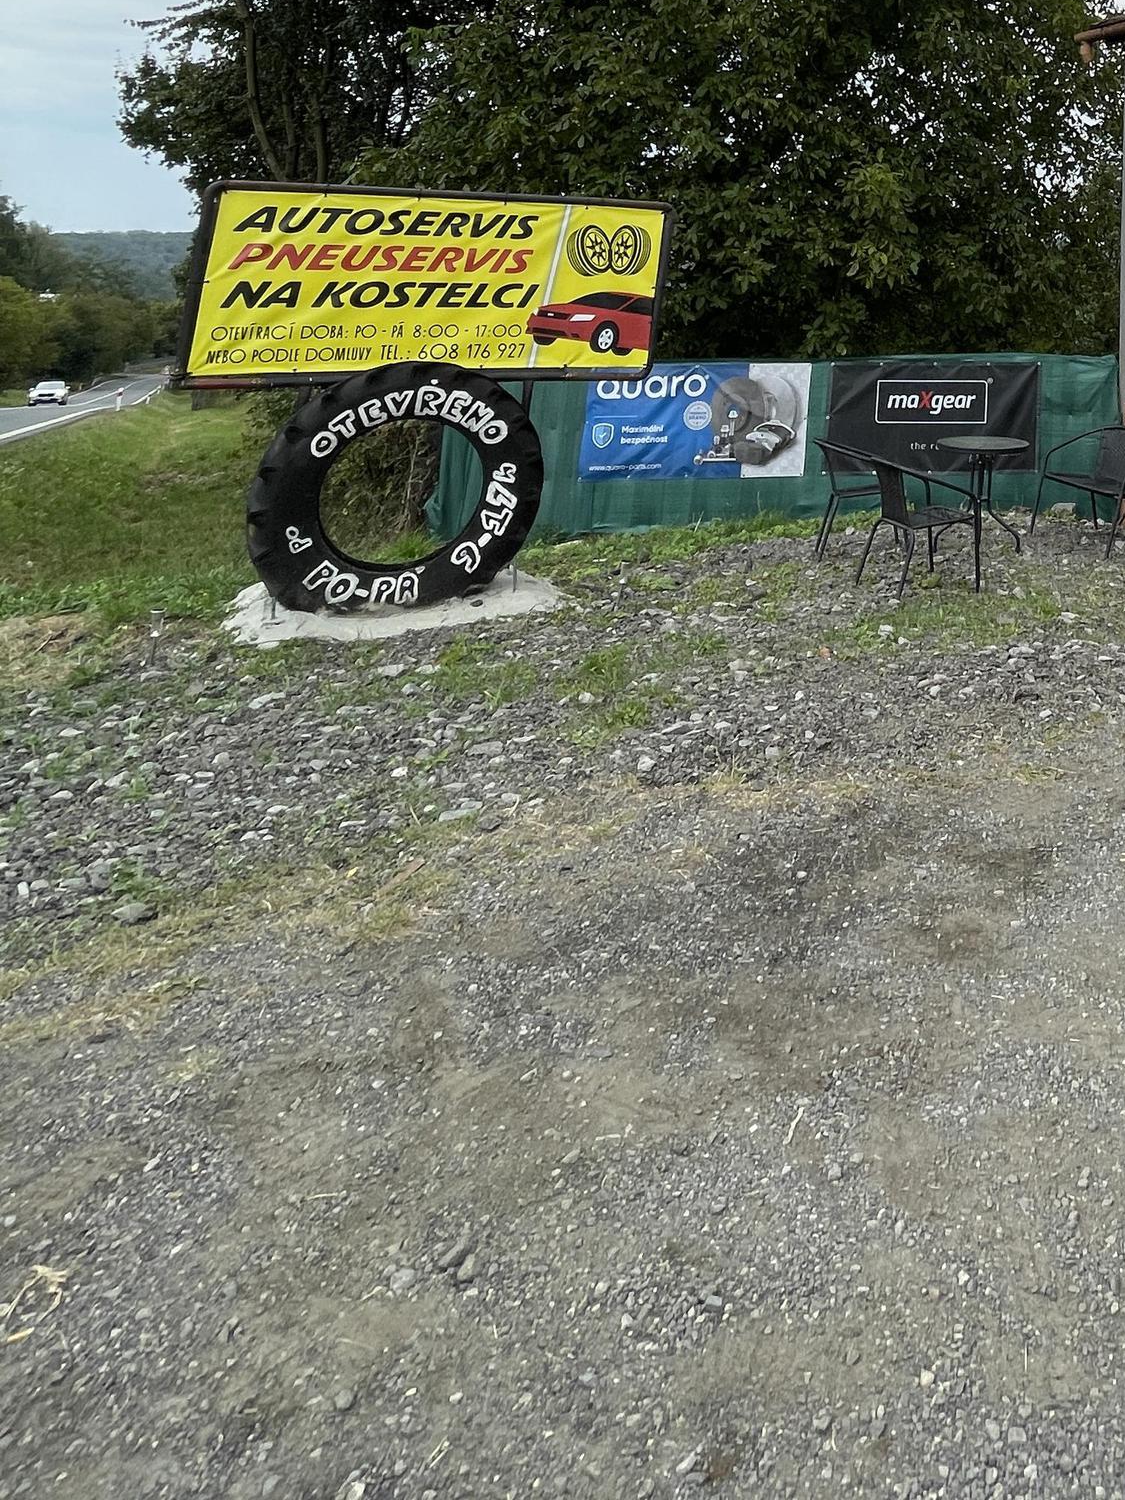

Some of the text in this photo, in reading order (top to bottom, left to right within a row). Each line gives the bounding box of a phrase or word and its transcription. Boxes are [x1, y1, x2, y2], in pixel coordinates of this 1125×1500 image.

[233, 206, 539, 239] AUTOSERVIS
[227, 243, 534, 274] PNEUSERVIS
[219, 281, 540, 309] NA KOSTELCI
[211, 322, 296, 341] OTEVÍRACÍ
[300, 325, 349, 340] DOBA:
[354, 324, 377, 339] PO
[391, 321, 405, 338] PÁ
[412, 323, 459, 338] 8:00
[475, 323, 522, 338] 17:00
[205, 343, 526, 364] NEBO PODLE DOMLUVY TEL.: 608 176 927
[310, 379, 509, 458] OTEVŘENO
[910, 442, 926, 450] the
